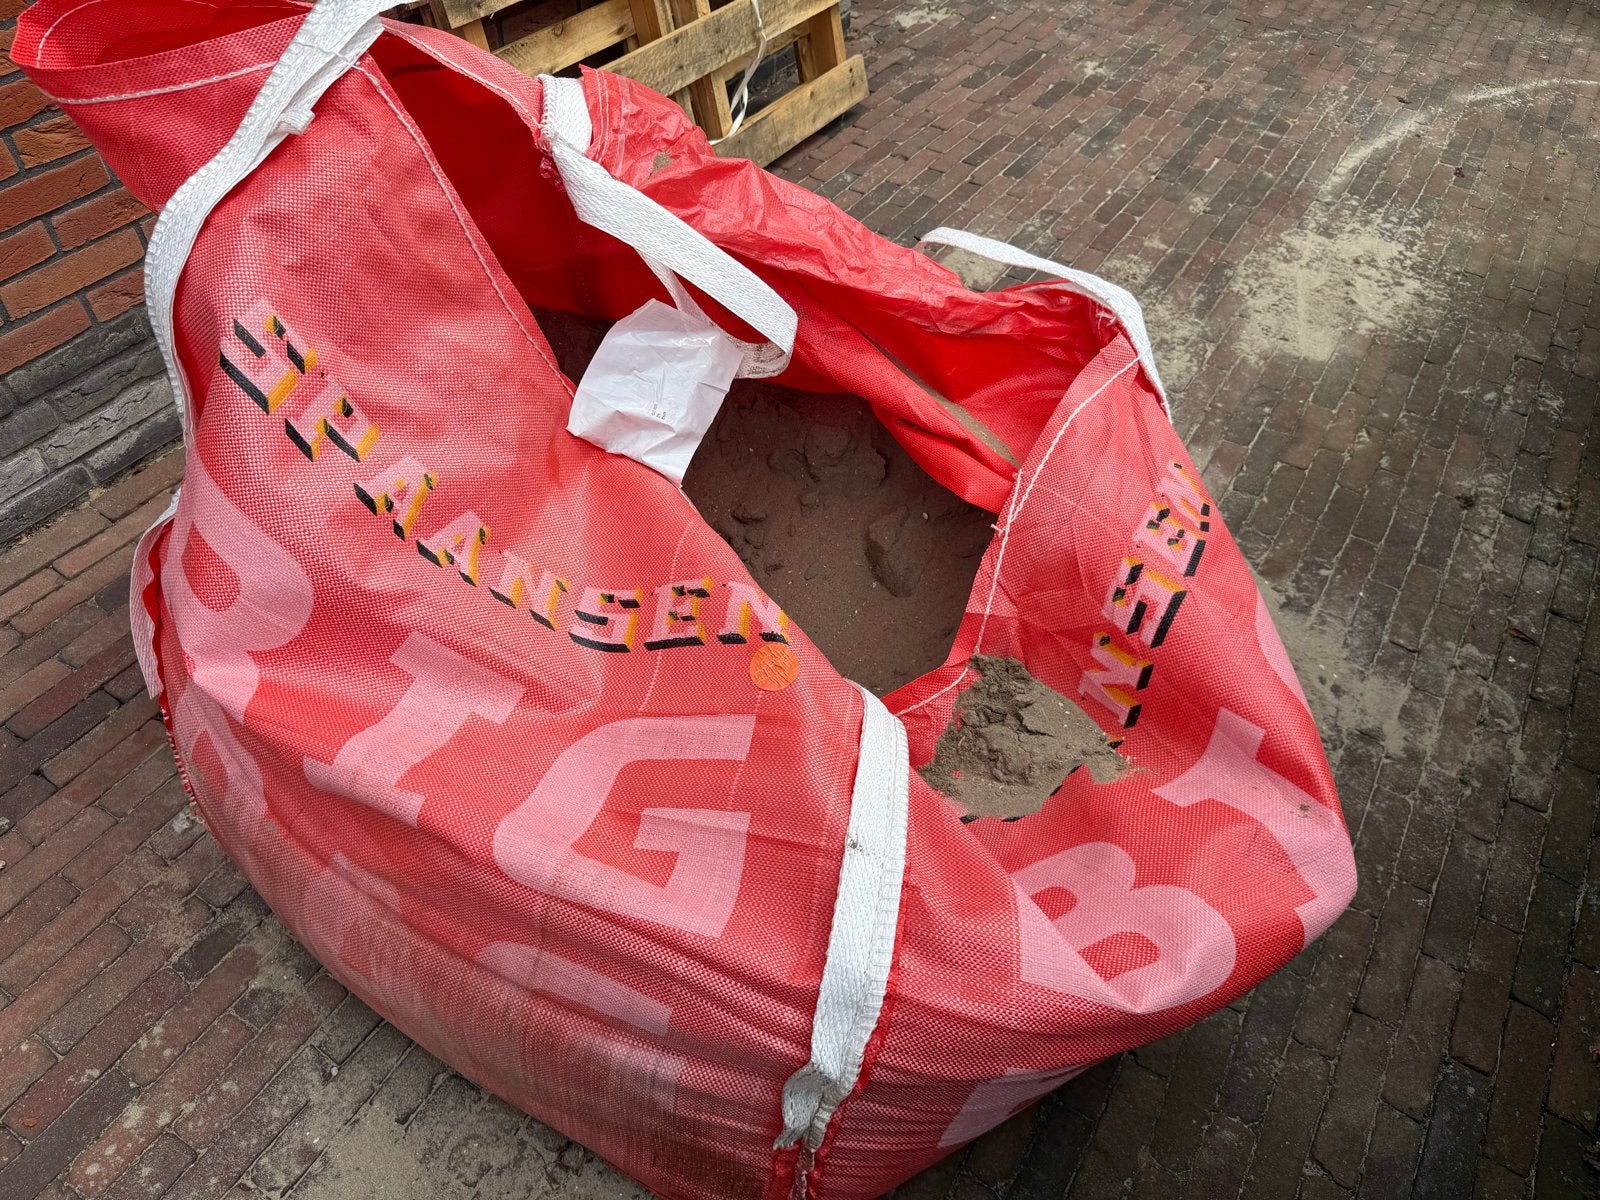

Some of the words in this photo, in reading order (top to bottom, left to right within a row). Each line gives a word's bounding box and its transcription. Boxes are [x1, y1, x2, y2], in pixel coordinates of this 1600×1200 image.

[219, 299, 791, 653] SPAANSEN
[161, 450, 756, 939] BIG
[1004, 597, 1357, 1014] BI
